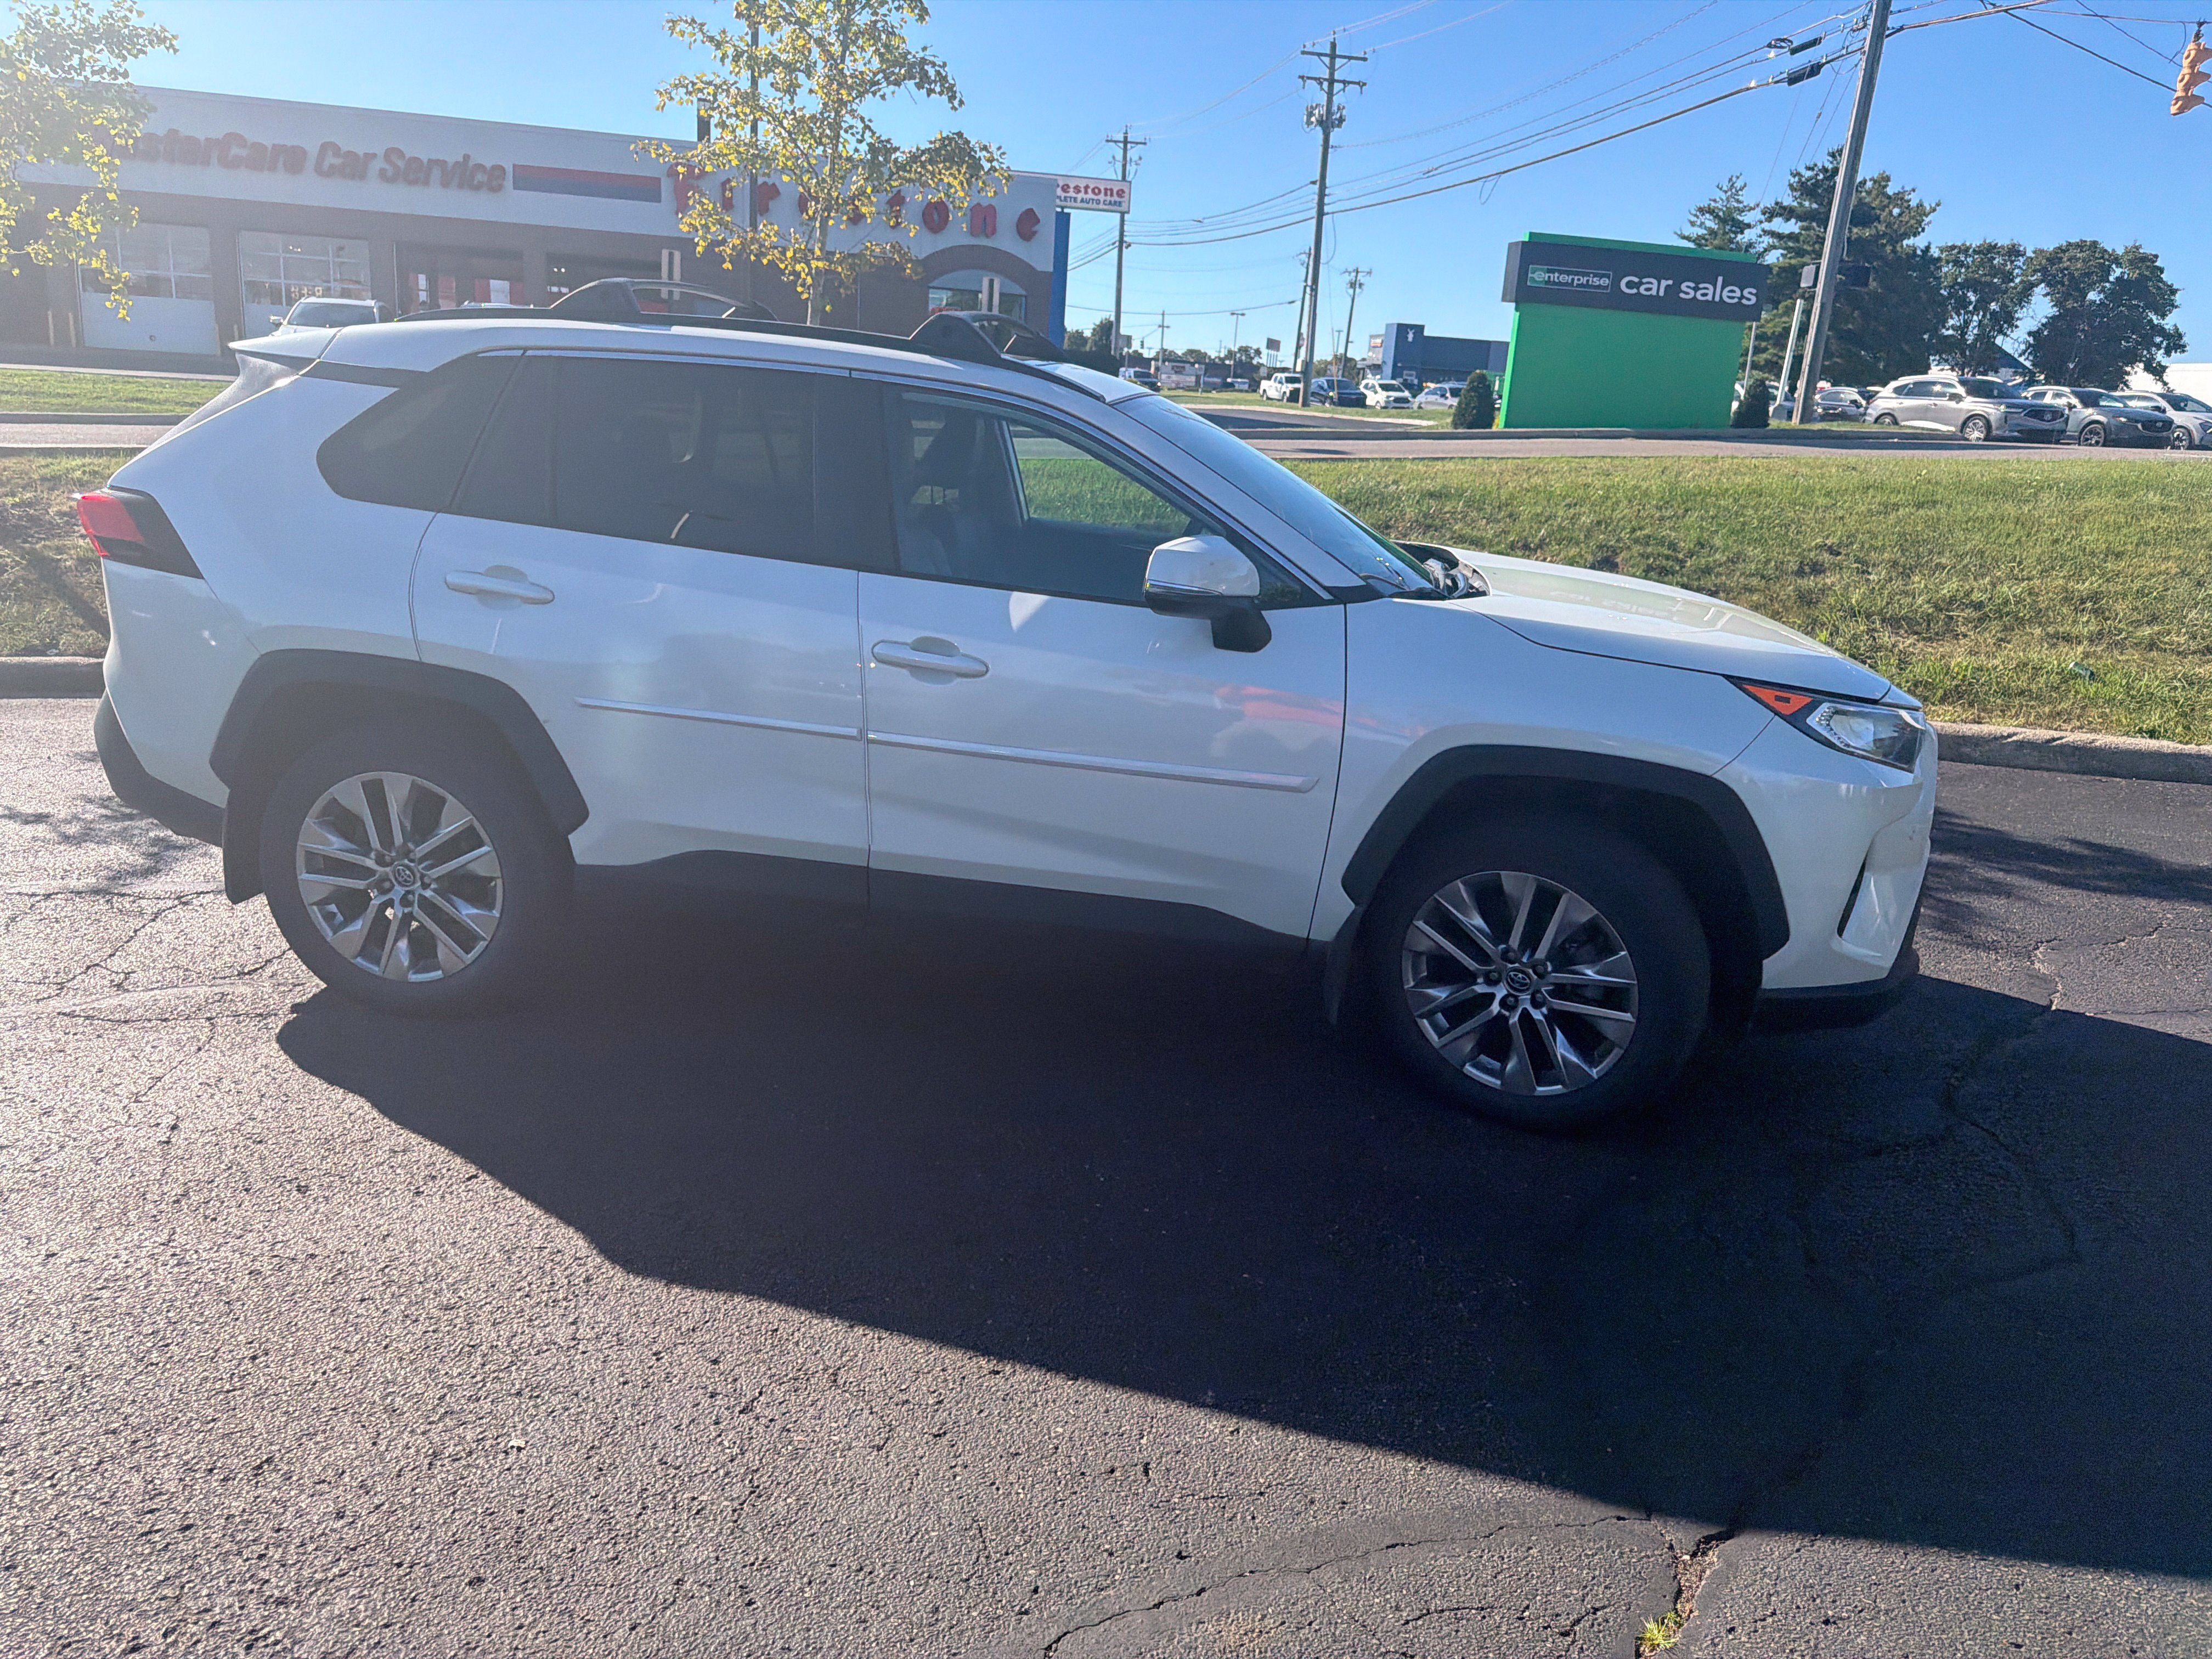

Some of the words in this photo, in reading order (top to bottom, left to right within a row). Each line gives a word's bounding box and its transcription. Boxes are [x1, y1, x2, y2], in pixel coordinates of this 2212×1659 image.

[91, 128, 307, 174] sterCare
[314, 141, 377, 180] Car
[379, 146, 506, 193] Service
[1057, 183, 1126, 199] estone
[1080, 197, 1101, 206] AUTO
[1103, 199, 1122, 207] CARE
[1533, 271, 1609, 287] enterprise
[1620, 276, 1673, 297] car
[1679, 276, 1757, 306] sales
